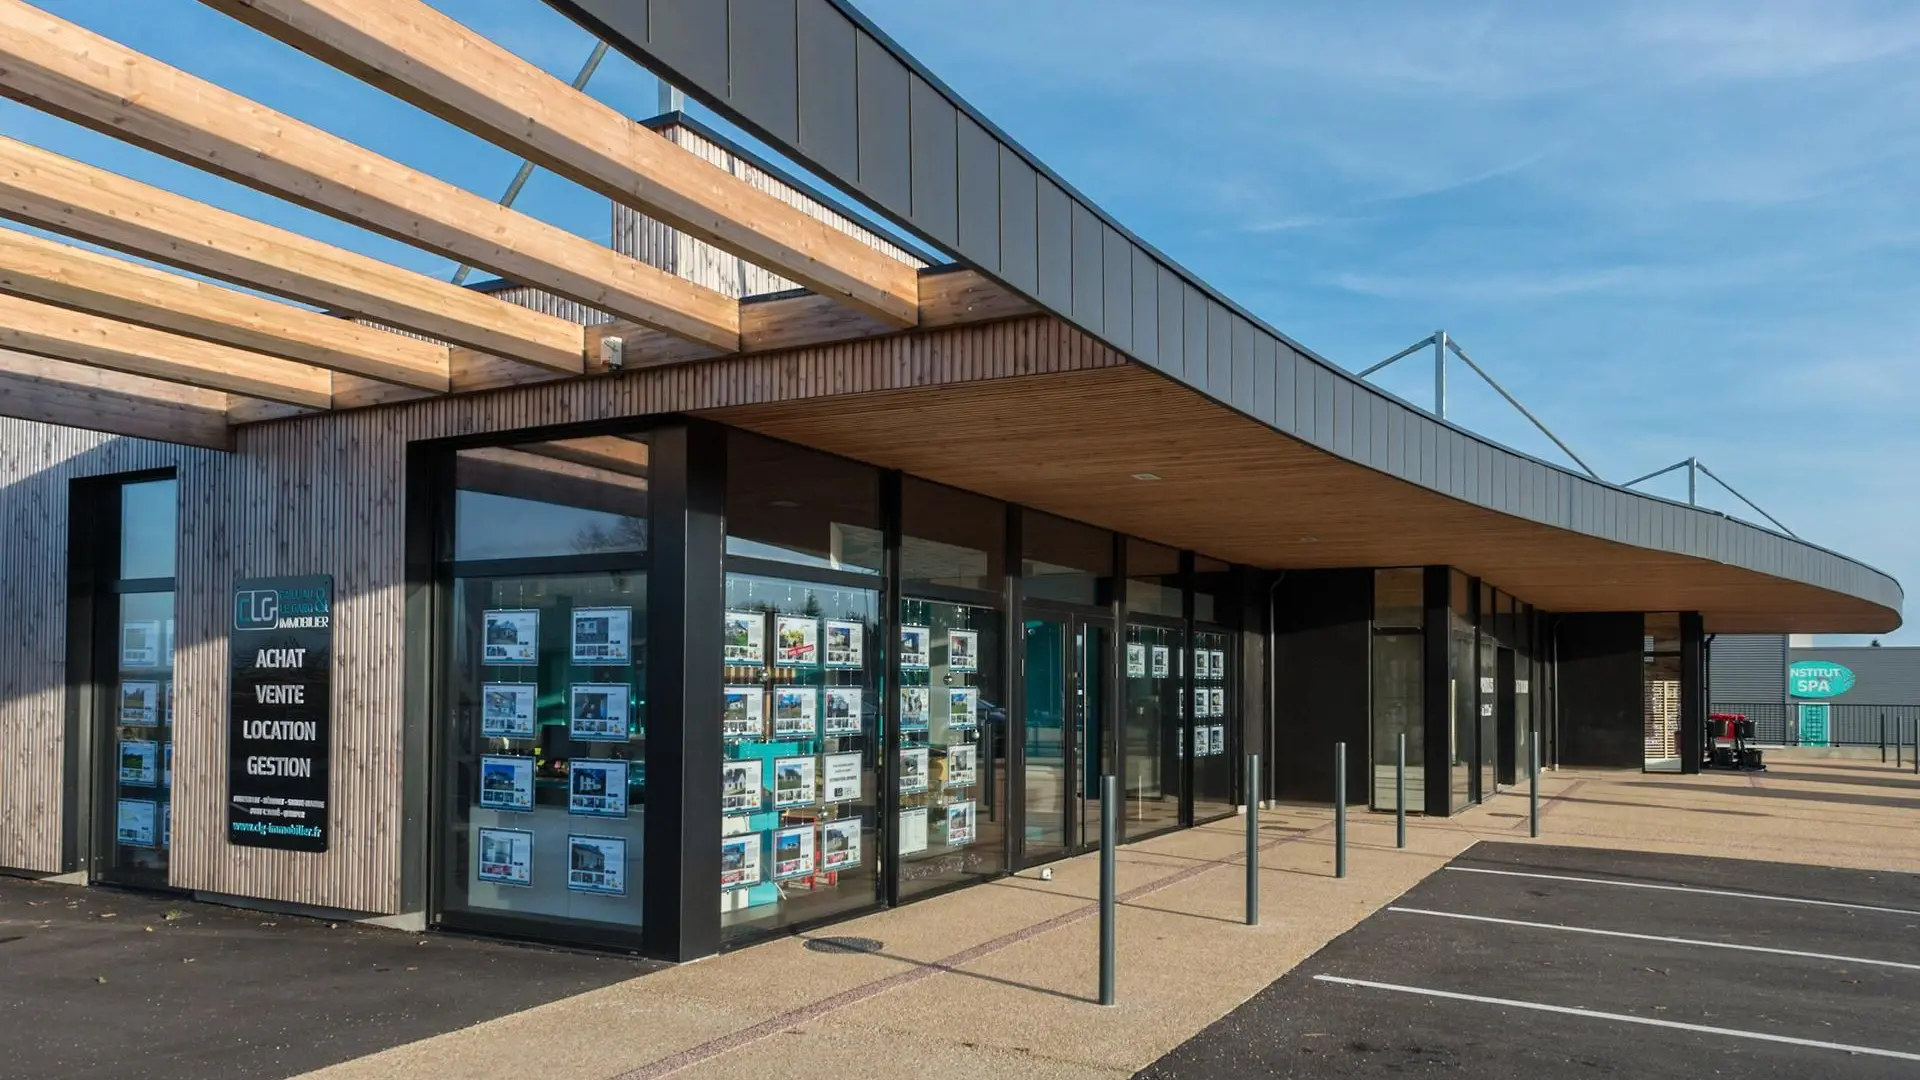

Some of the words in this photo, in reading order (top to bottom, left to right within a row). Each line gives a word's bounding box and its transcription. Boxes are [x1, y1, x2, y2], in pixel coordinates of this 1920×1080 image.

[279, 616, 329, 629] IMMOBILIER
[255, 648, 306, 668] ACHAT
[1790, 668, 1841, 677] NSTITUT
[255, 684, 305, 704] VENTE
[1797, 680, 1830, 692] SPA
[243, 720, 316, 741] LOCATION
[247, 756, 311, 778] GESTION
[232, 821, 322, 838] www.clg-immobilier.fr
